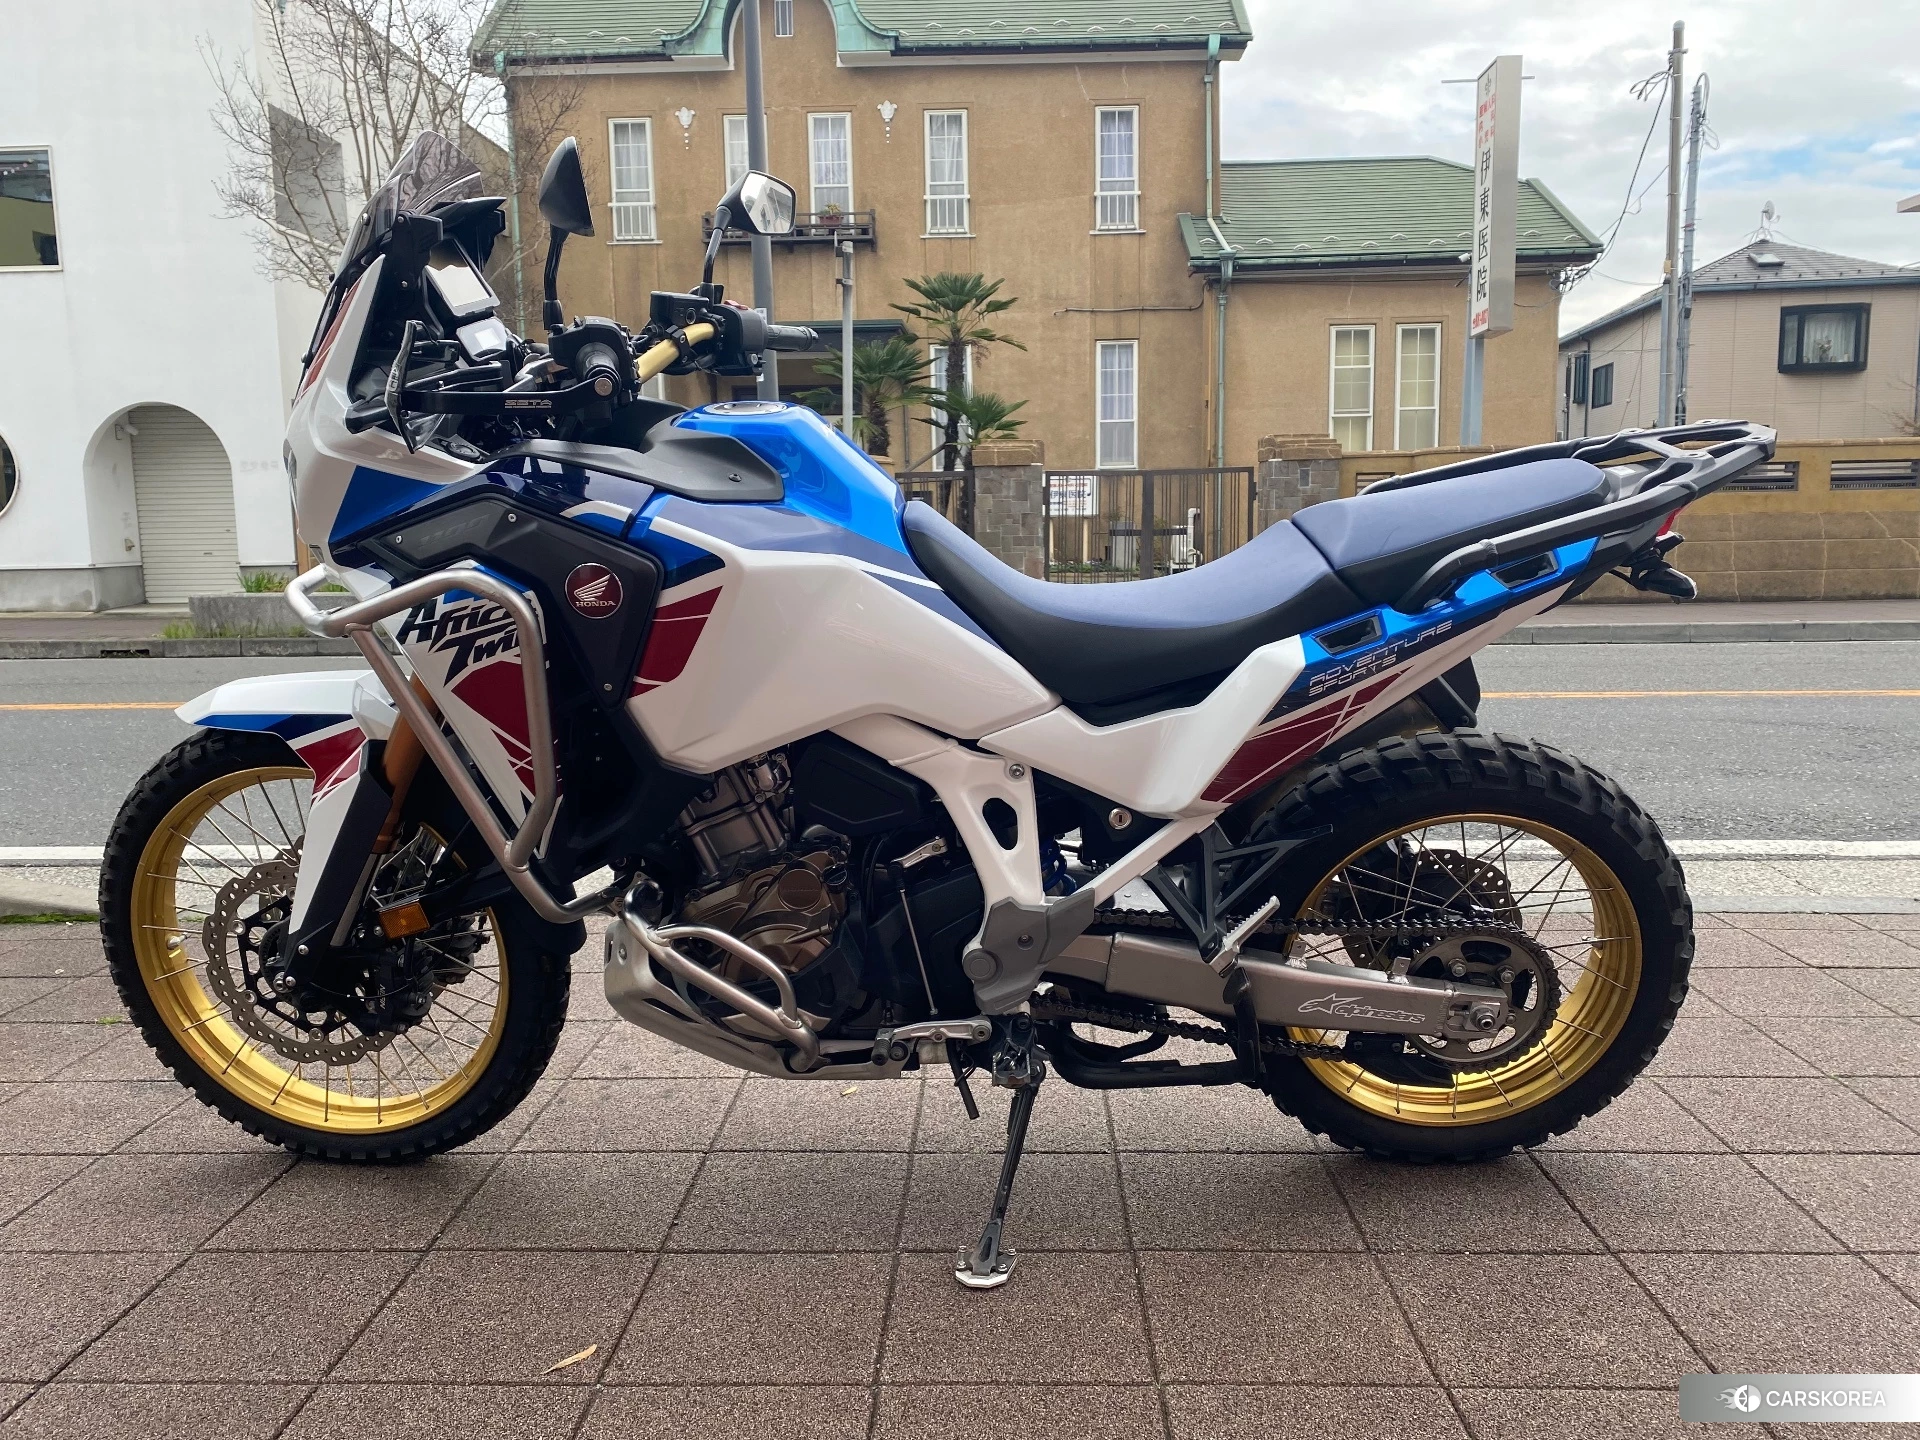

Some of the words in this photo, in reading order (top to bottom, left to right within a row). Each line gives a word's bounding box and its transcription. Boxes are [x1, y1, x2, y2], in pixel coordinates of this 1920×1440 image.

[1476, 147, 1491, 303] 伊東医院
[395, 597, 516, 653] Afric
[433, 620, 519, 688] Twi
[1309, 619, 1453, 687] ADVENTURE
[1308, 653, 1397, 697] SPORTS
